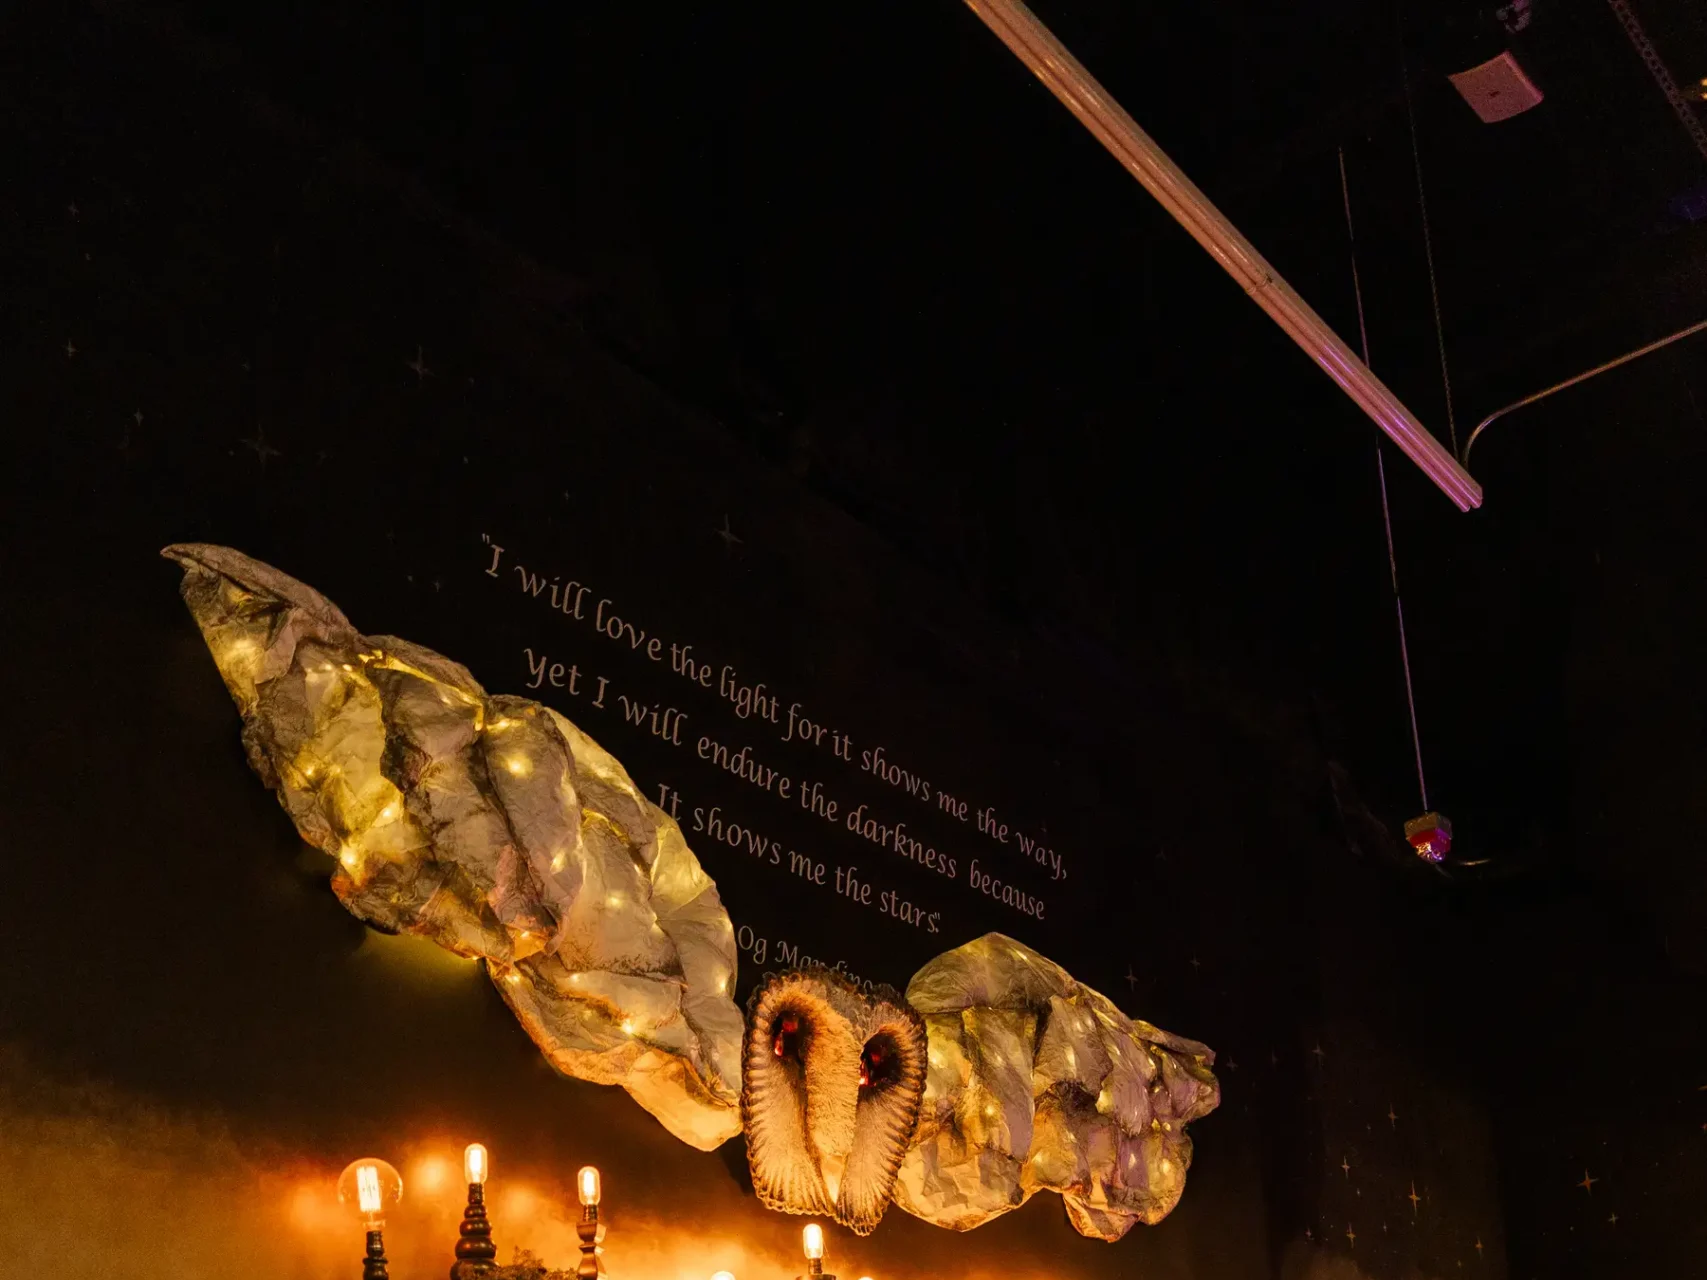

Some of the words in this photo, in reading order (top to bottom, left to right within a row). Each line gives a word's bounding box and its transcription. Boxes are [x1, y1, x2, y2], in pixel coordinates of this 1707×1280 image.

[513, 565, 592, 620] will
[595, 598, 663, 662] love
[669, 642, 713, 688] the
[719, 664, 780, 725] light
[780, 702, 828, 747] for
[831, 729, 854, 762] it
[860, 746, 931, 802] shows
[936, 790, 969, 822] me
[976, 806, 1010, 844] the
[1014, 831, 1068, 881] way,
[523, 647, 582, 696] yet
[591, 675, 611, 710] I
[617, 694, 689, 747] will
[697, 734, 792, 800] endure
[799, 780, 839, 823] the
[846, 803, 958, 880] darkness
[968, 858, 1046, 921] because
[691, 806, 783, 866] shows
[787, 850, 827, 886] me
[834, 865, 873, 906] the
[737, 924, 768, 965] Og
[774, 939, 874, 995] Manno
